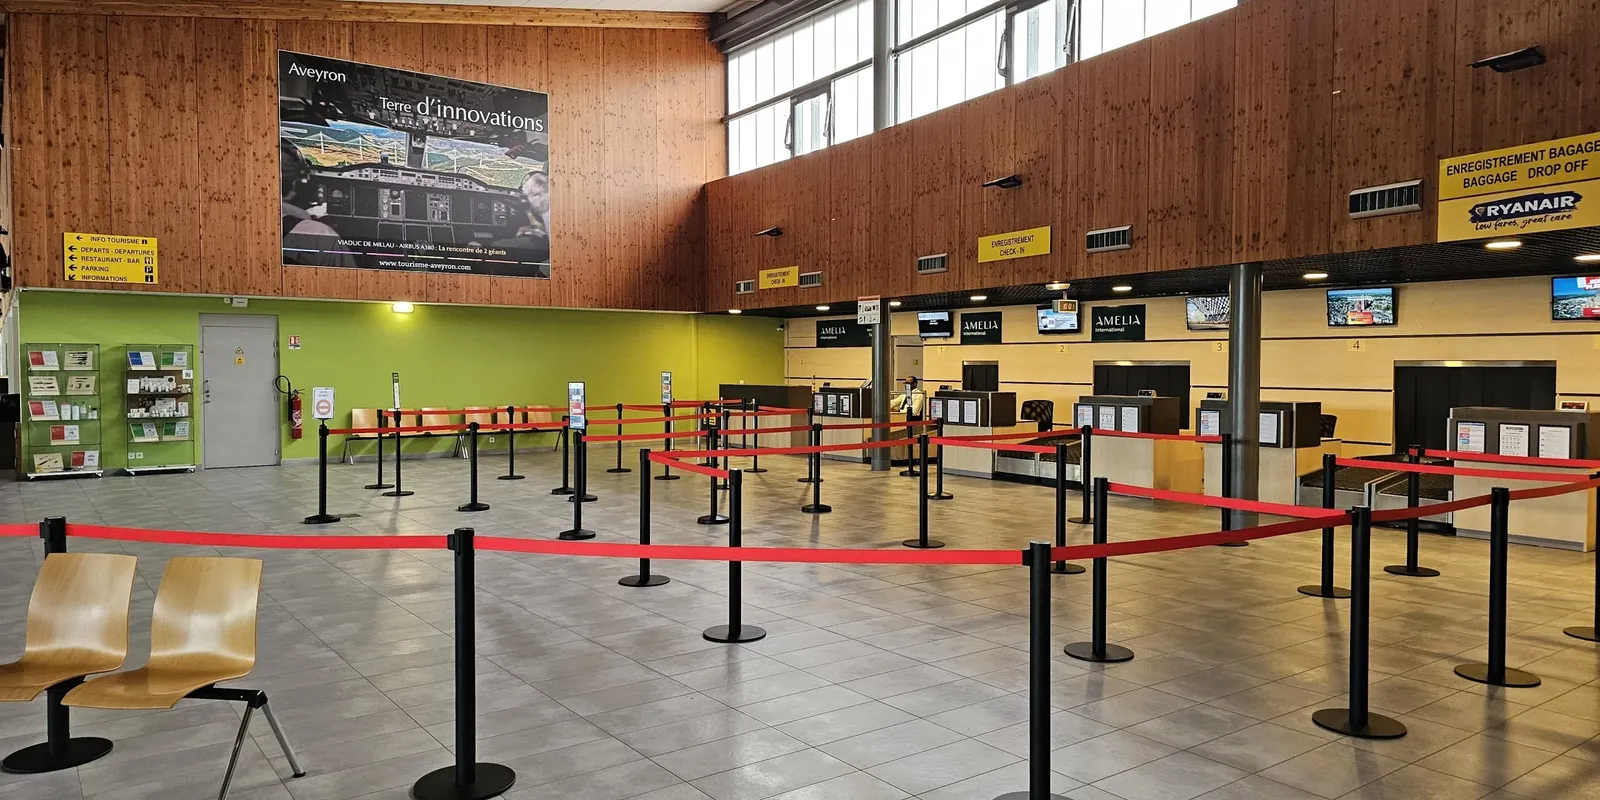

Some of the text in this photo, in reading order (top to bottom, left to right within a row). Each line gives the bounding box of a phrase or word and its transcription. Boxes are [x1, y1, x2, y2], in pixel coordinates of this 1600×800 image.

[288, 62, 346, 82] Aveyron
[379, 95, 544, 132] Terre d'innovations
[1446, 140, 1600, 176] ENREGISTREMENT BAGAGE
[1463, 159, 1589, 189] BAGGAGE DROP OFF
[1486, 195, 1575, 217] RYANAIR
[1494, 218, 1518, 230] fares,
[1520, 213, 1547, 229] great
[1550, 214, 1572, 222] care
[337, 239, 362, 247] VIADUC
[991, 235, 1034, 248] ENREGISTREMENT
[1000, 248, 1016, 256] CHECK
[379, 260, 471, 271] www.tourisme-aveyron.com
[963, 320, 999, 330] AMELIA
[1095, 315, 1141, 326] AMELIA
[820, 326, 846, 335] AMELIA
[1216, 342, 1223, 351] 3
[1352, 340, 1360, 350] 4
